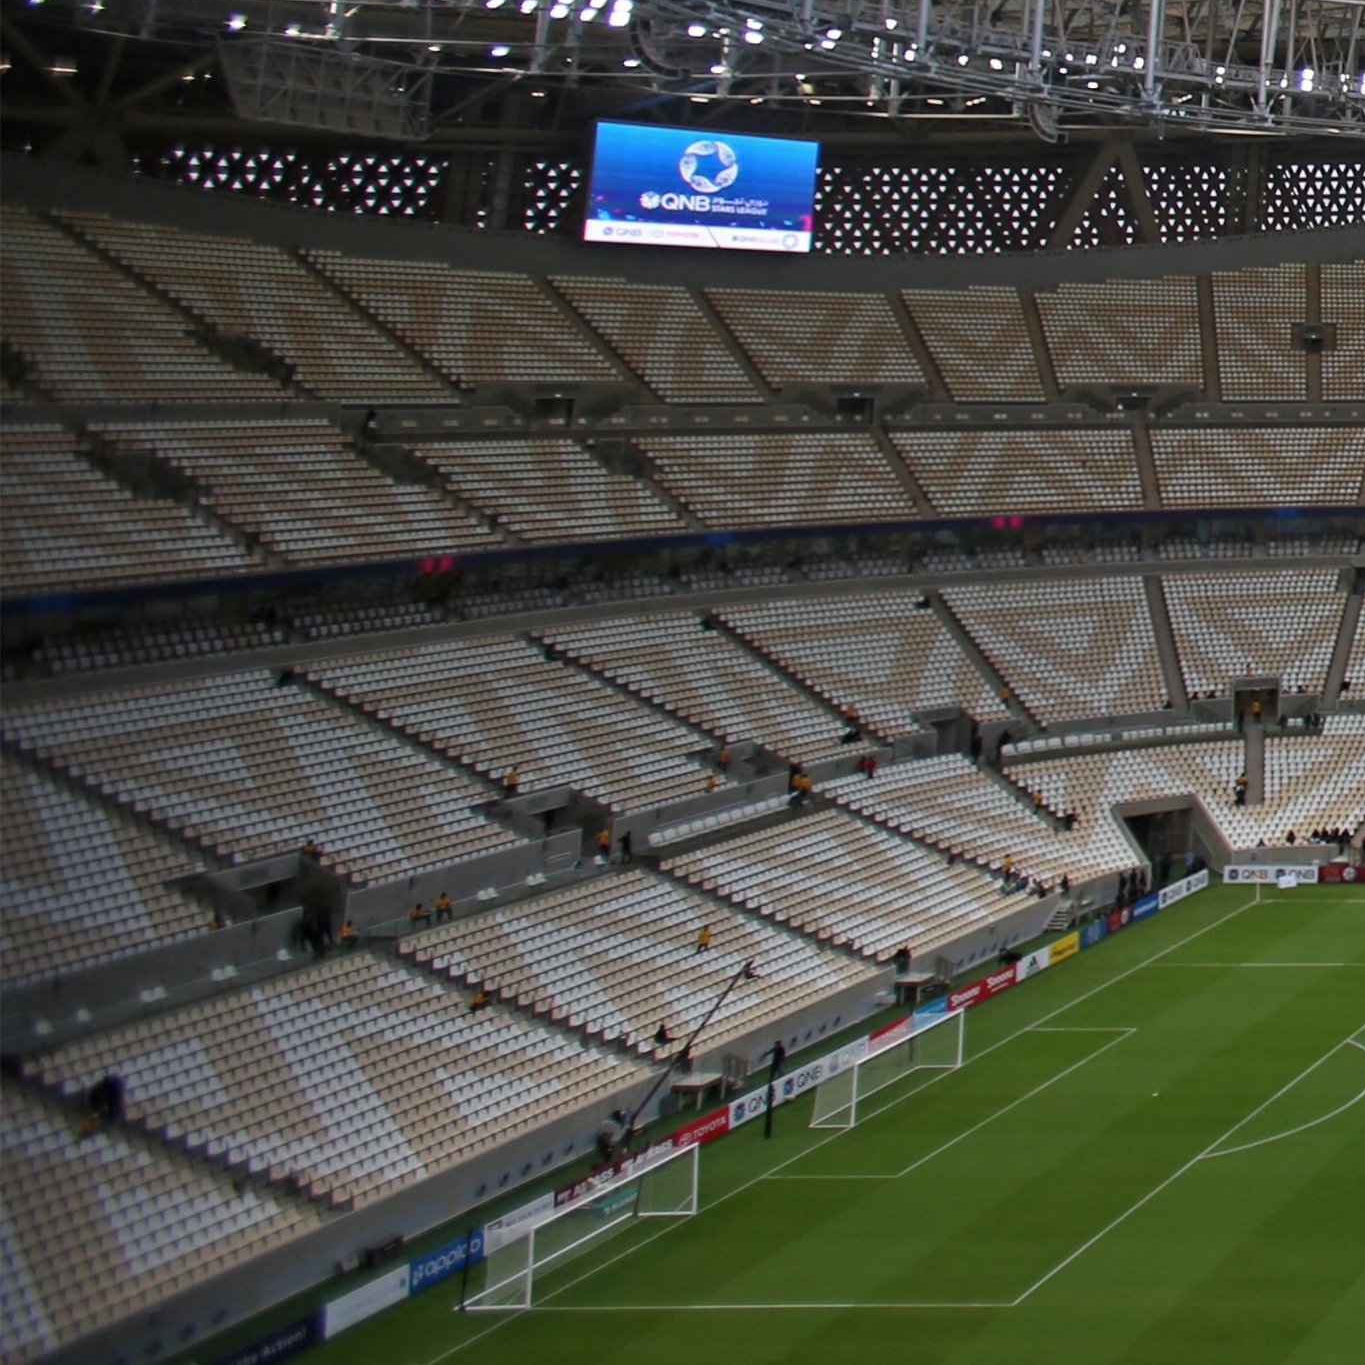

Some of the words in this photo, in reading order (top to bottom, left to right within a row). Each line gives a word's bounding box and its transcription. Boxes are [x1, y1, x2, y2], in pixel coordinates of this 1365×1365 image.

[661, 192, 711, 212] QNB
[712, 204, 735, 213] STARS
[736, 206, 767, 215] LEAGUE
[616, 227, 642, 237] QNB
[796, 1064, 823, 1088] QNB
[693, 1116, 726, 1139] TOYOTA
